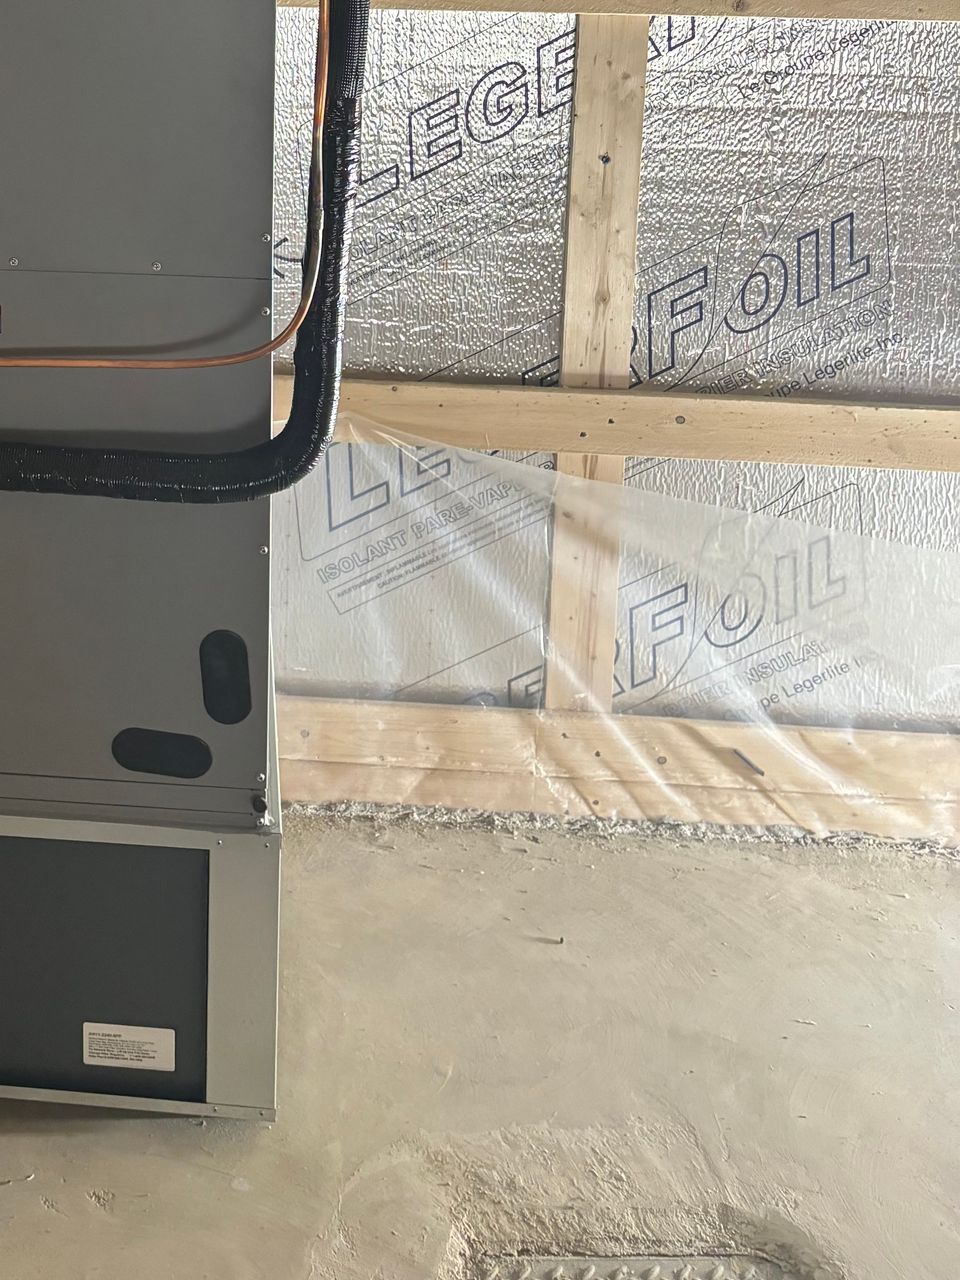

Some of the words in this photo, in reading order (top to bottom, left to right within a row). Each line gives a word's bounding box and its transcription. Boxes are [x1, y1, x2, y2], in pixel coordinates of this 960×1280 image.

[764, 50, 825, 86] Groupe
[754, 299, 891, 377] INSULATION
[803, 345, 874, 386] Legerlite
[876, 331, 909, 352] Inc.
[316, 529, 407, 584] ISOLANT
[784, 661, 851, 699] Legerlite
